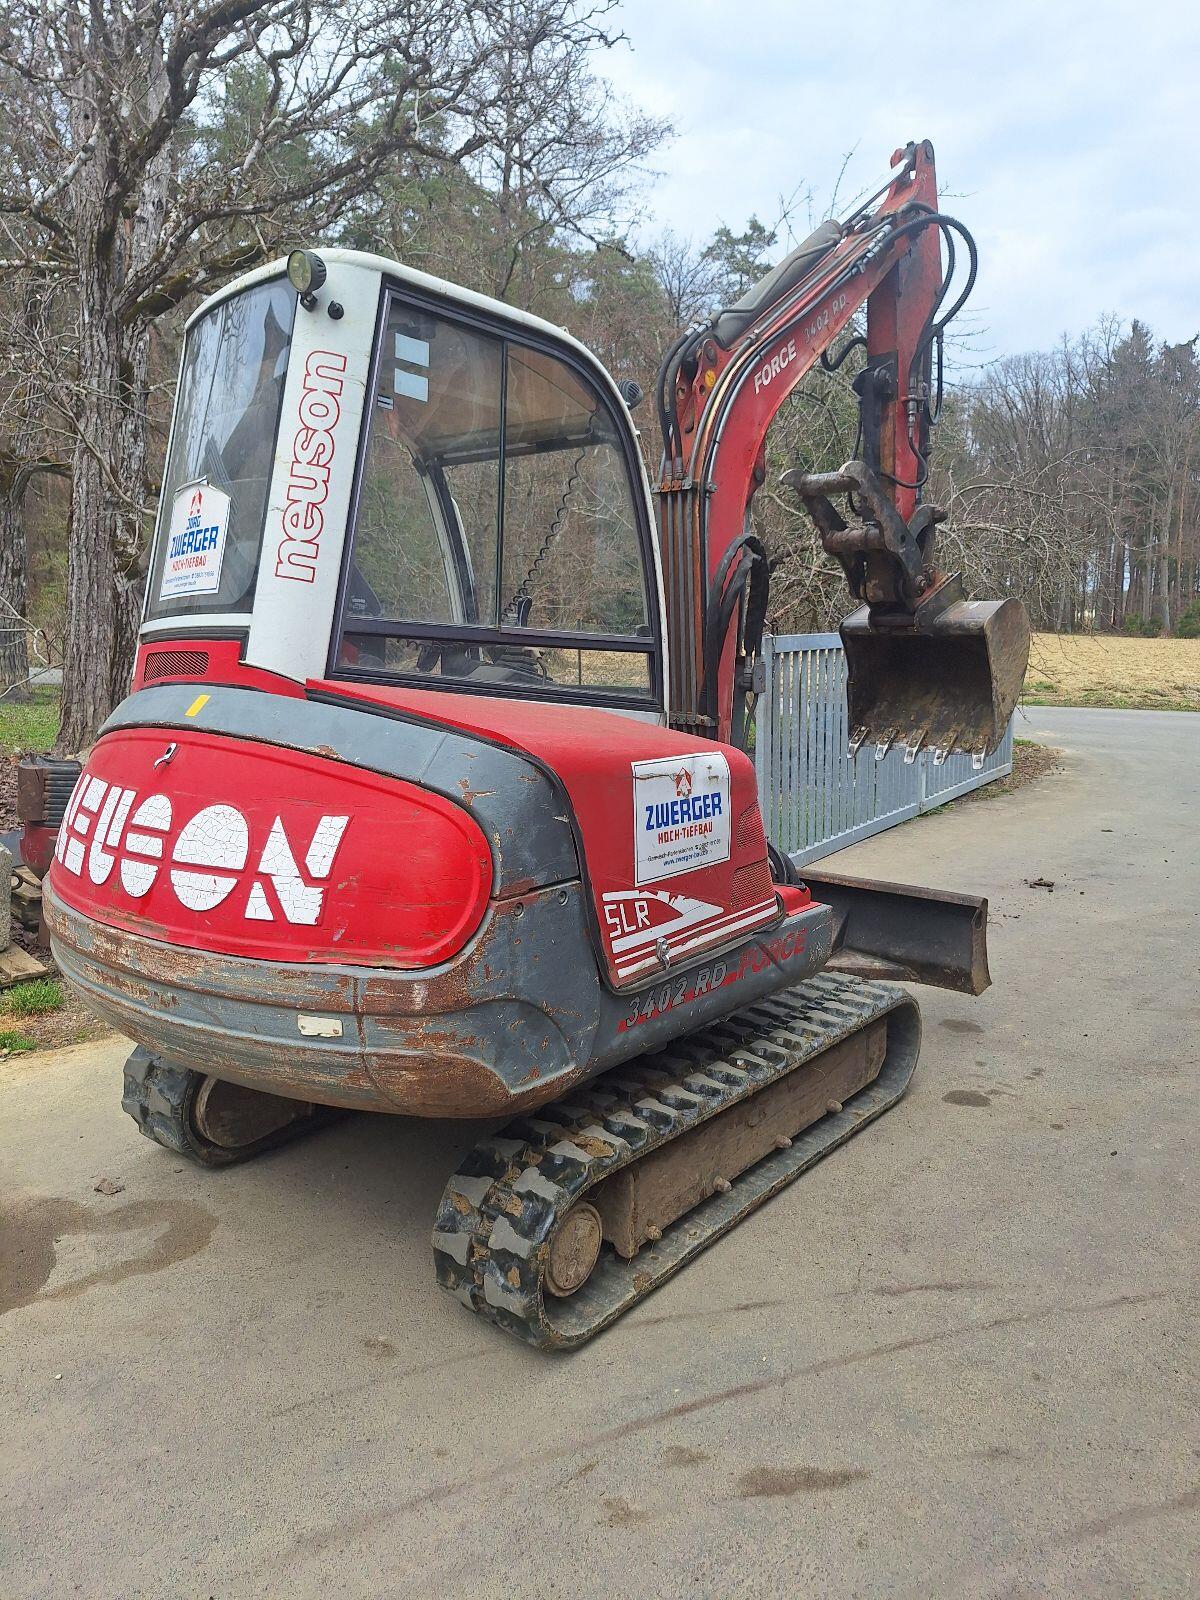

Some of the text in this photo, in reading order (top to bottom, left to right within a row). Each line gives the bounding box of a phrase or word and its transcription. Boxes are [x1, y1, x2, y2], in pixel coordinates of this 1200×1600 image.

[754, 338, 797, 394] FORCE
[275, 350, 347, 583] neuson
[170, 526, 219, 558] ZWERGER
[646, 792, 722, 831] ZWERGER
[604, 900, 651, 938] SLR
[626, 927, 808, 1027] 3402 RD FORCE
